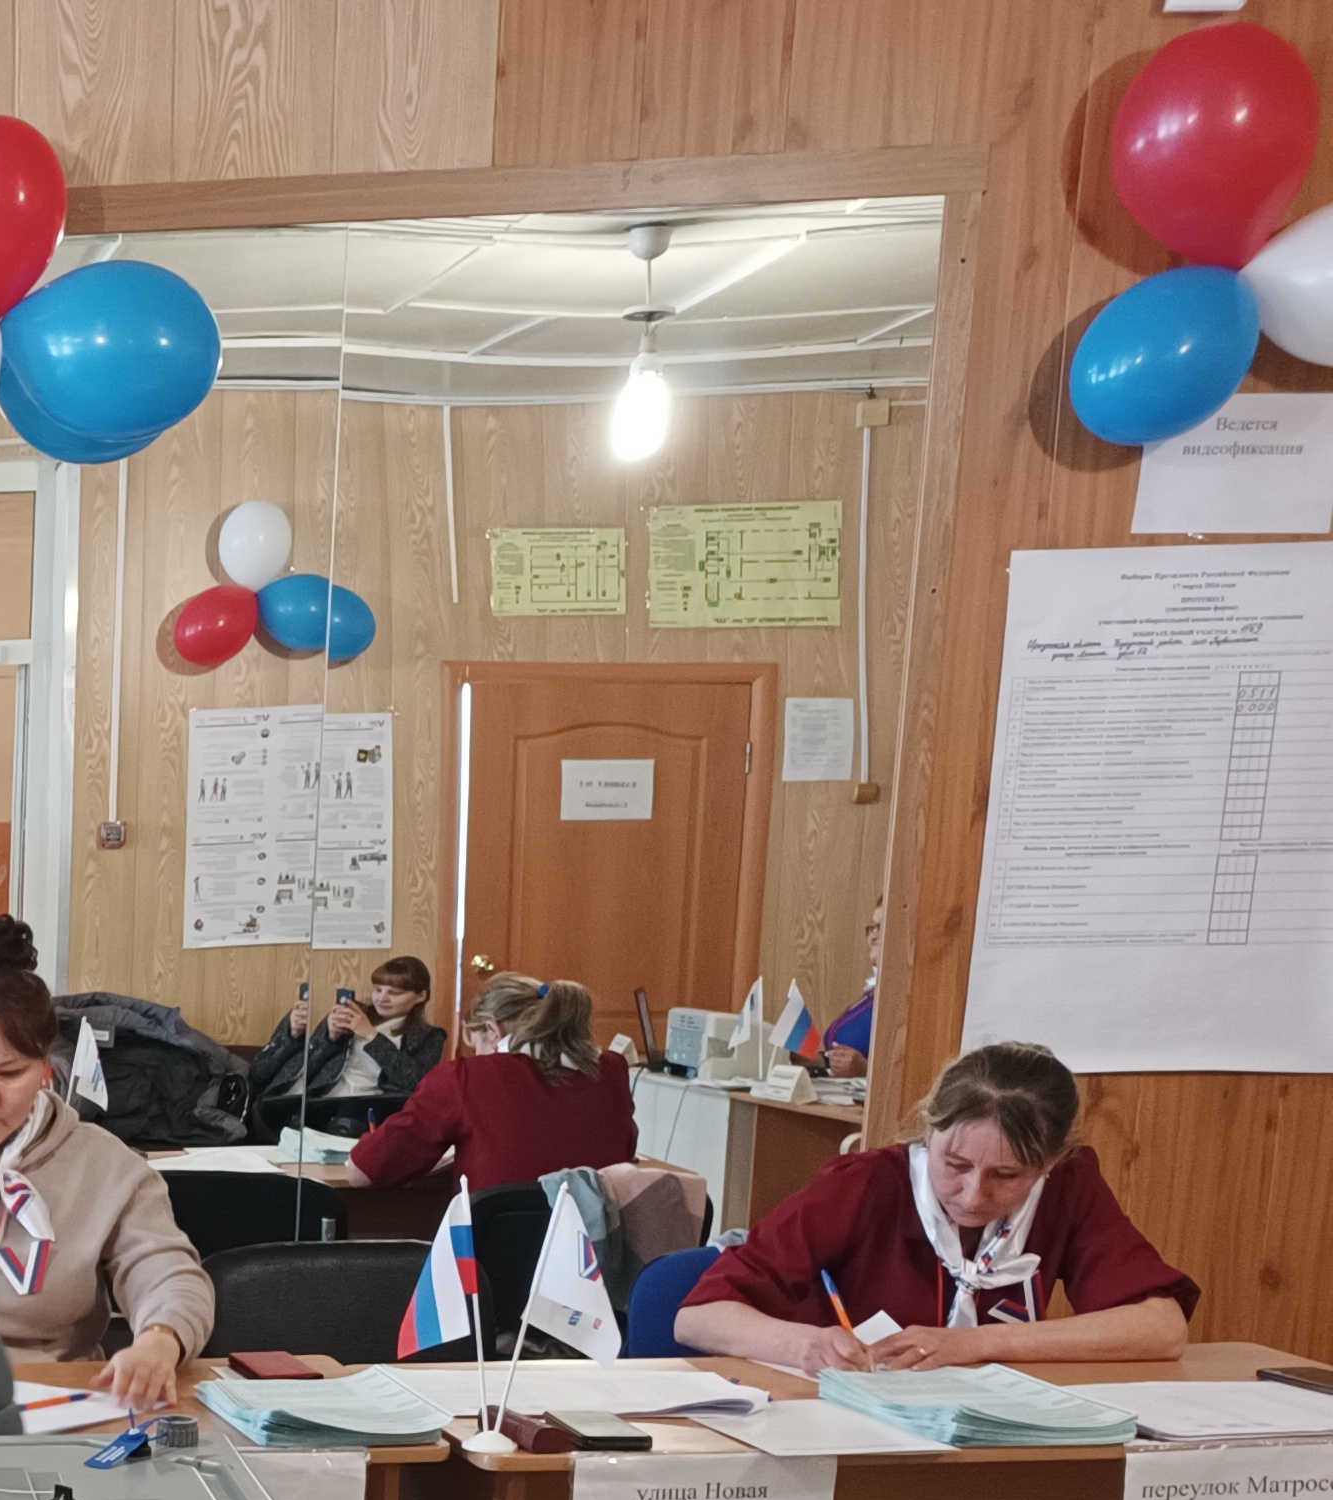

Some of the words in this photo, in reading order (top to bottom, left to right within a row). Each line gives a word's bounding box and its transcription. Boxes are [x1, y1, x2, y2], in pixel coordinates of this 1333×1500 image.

[1215, 417, 1278, 432] Ведется
[1182, 441, 1304, 459] видеофиксация
[705, 1482, 768, 1500] Новая
